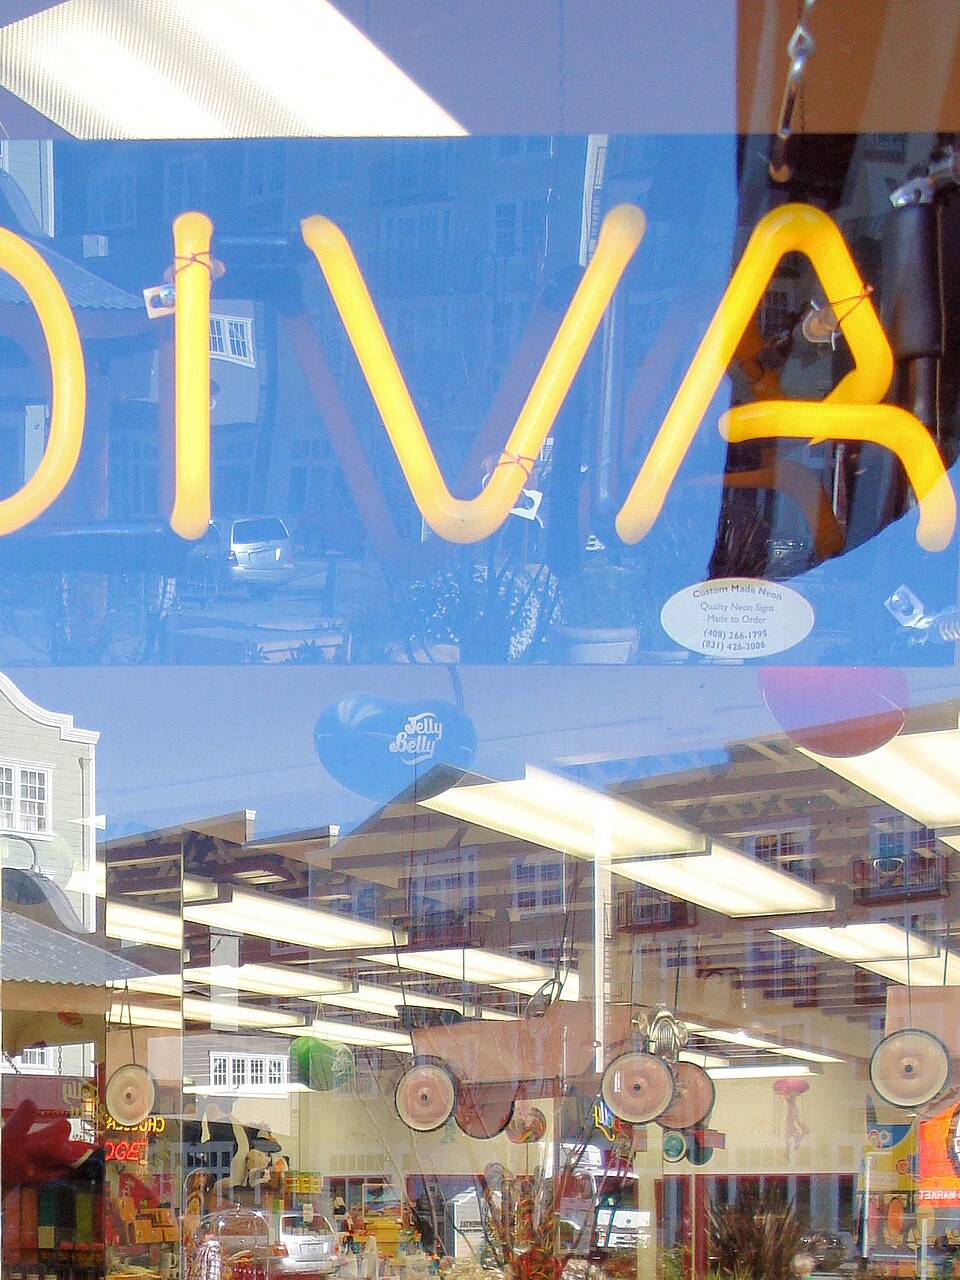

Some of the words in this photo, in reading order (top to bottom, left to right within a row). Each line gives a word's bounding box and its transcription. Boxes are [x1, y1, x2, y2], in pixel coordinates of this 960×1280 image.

[692, 585, 728, 598] Custom
[731, 585, 756, 595] Made
[758, 587, 782, 601] Neon
[700, 602, 728, 612] Quality
[730, 603, 753, 612] Neon
[755, 603, 775, 613] Signs
[707, 614, 728, 624] Made
[730, 615, 740, 624] to
[741, 614, 767, 624] Order
[703, 628, 726, 641] (408)
[405, 712, 442, 740] Jelly
[389, 731, 436, 765] Belly
